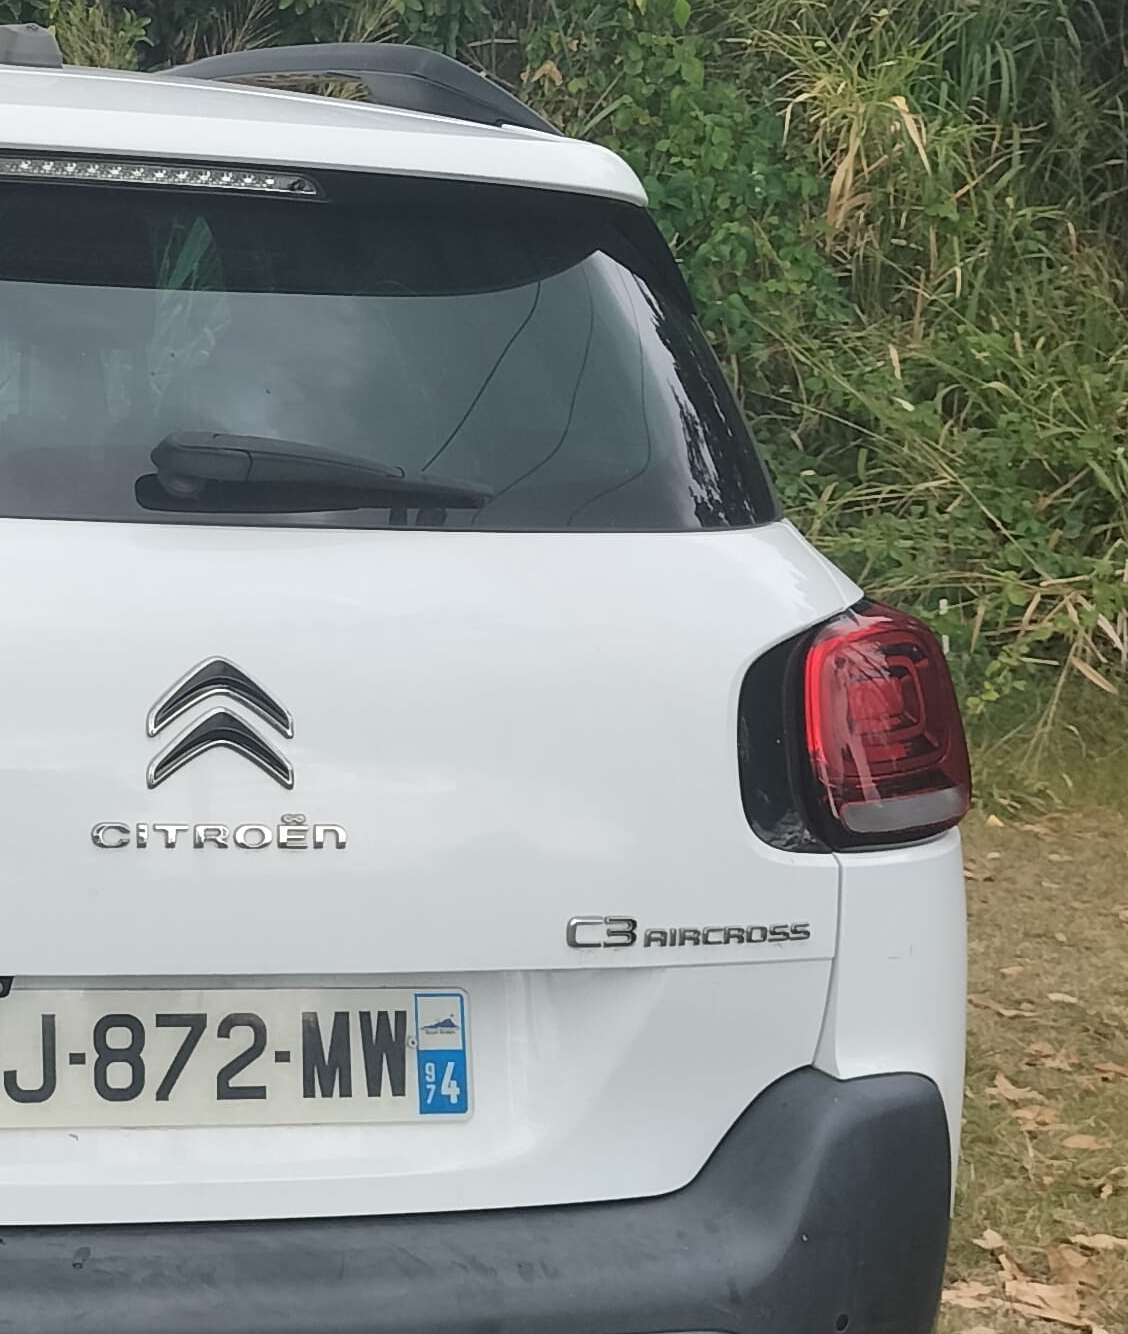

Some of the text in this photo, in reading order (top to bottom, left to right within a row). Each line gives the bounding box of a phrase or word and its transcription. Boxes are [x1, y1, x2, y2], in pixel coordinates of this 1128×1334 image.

[91, 814, 347, 849] CITROËN
[566, 916, 811, 948] C3 AIRCROSS
